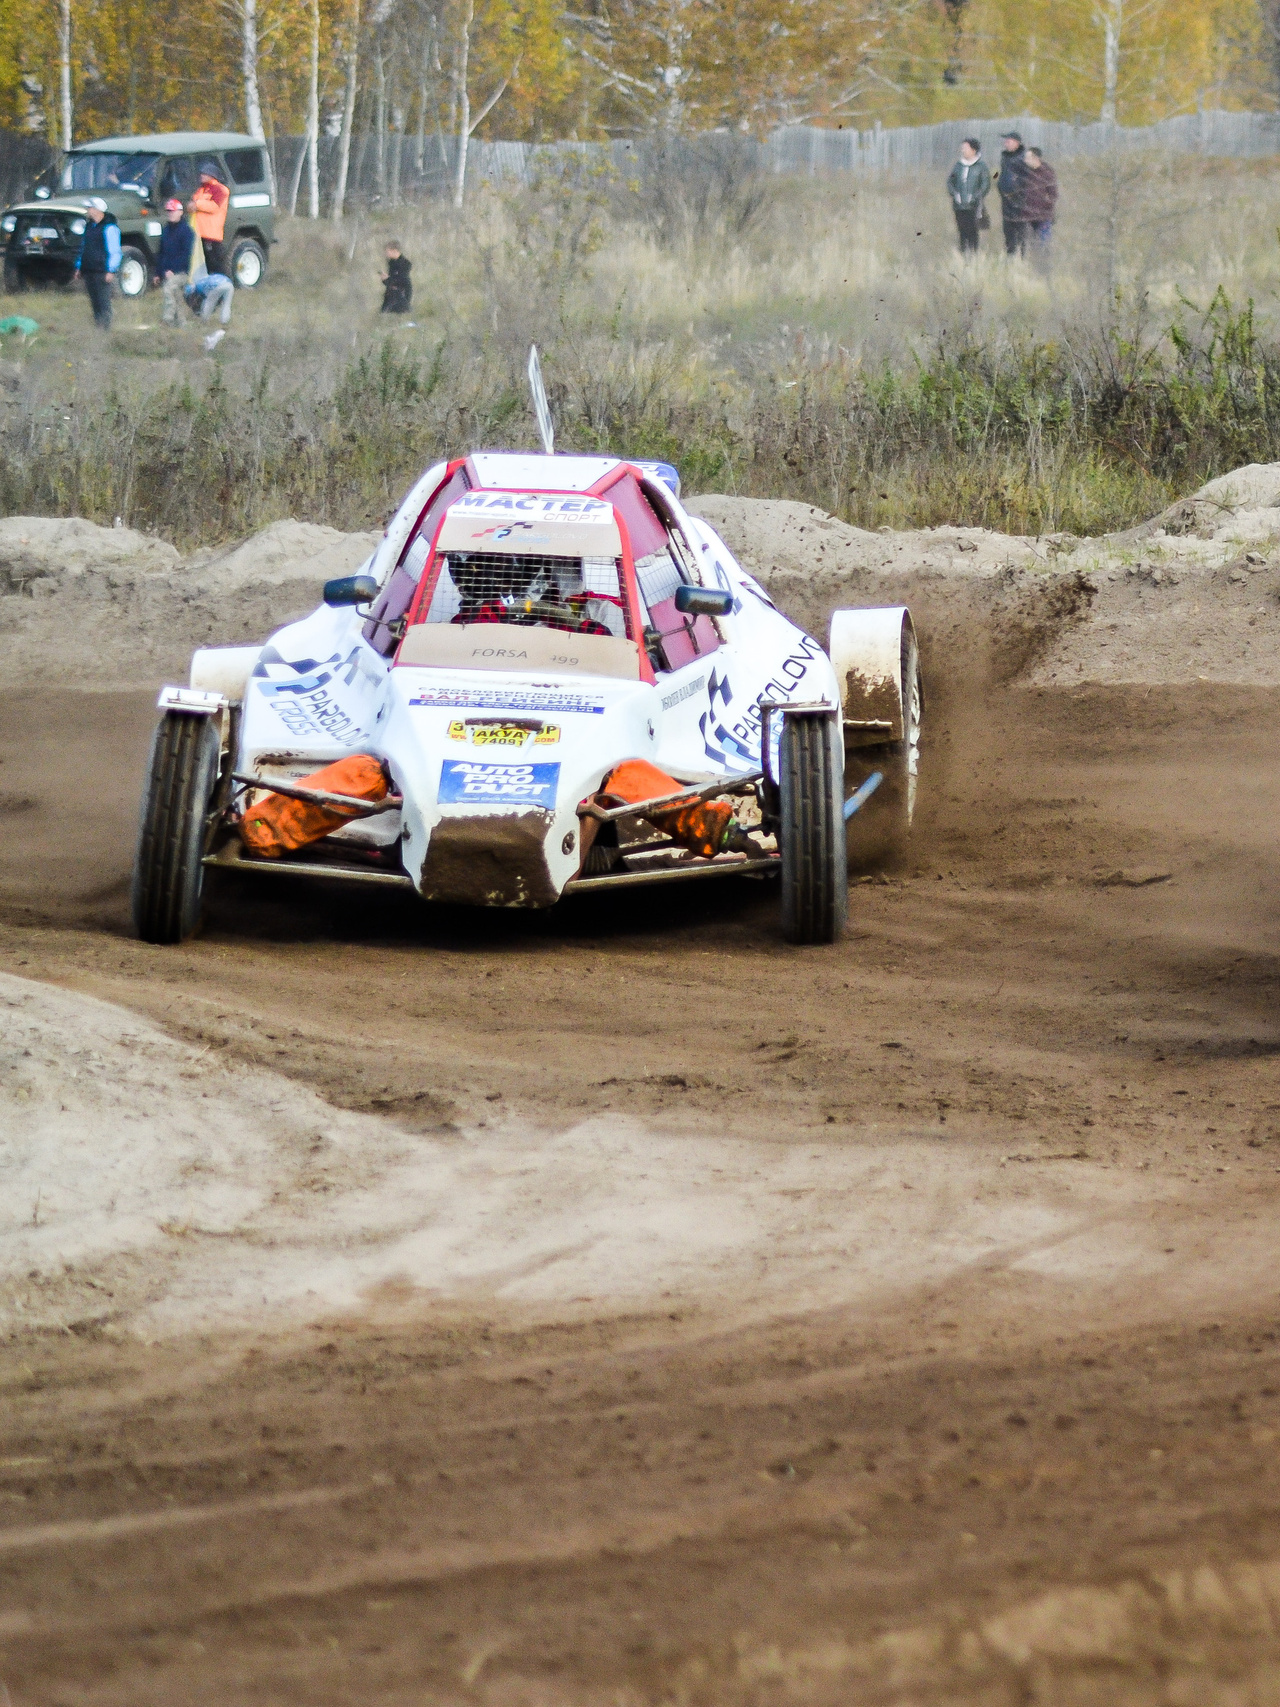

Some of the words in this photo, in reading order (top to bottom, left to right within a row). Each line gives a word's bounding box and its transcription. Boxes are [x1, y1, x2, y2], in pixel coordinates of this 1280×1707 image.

[453, 492, 608, 513] МАСТЕР
[543, 513, 601, 522] СПОРТ
[472, 648, 528, 659] FORSA
[450, 763, 533, 775] AUTO
[463, 773, 533, 784] PRO
[464, 783, 551, 795] DUCT
